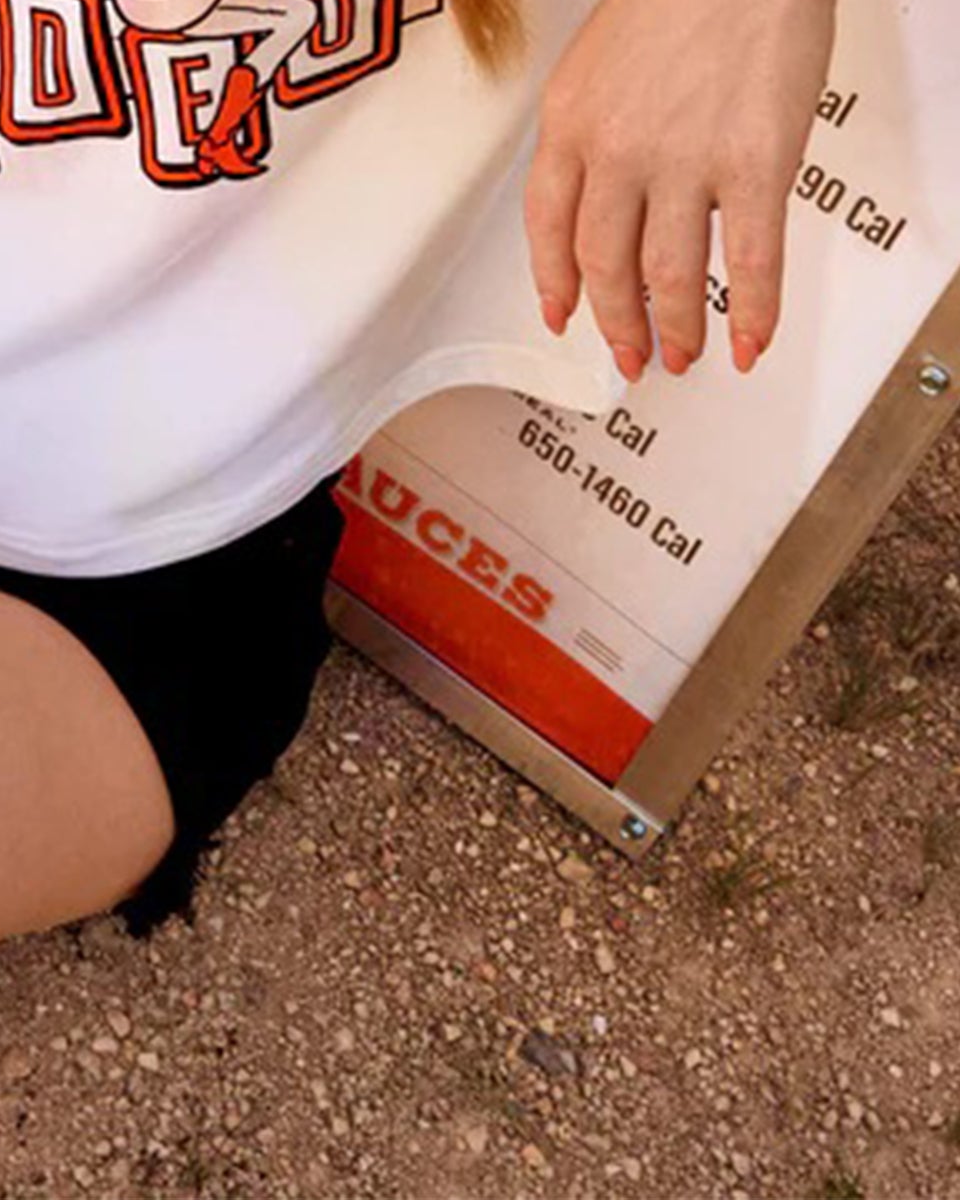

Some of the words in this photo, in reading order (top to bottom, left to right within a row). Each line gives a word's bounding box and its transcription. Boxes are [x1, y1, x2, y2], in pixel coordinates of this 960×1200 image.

[845, 196, 907, 251] Cal
[605, 406, 658, 458] Cal
[518, 418, 651, 529] 650-1460
[650, 516, 703, 566] Cal
